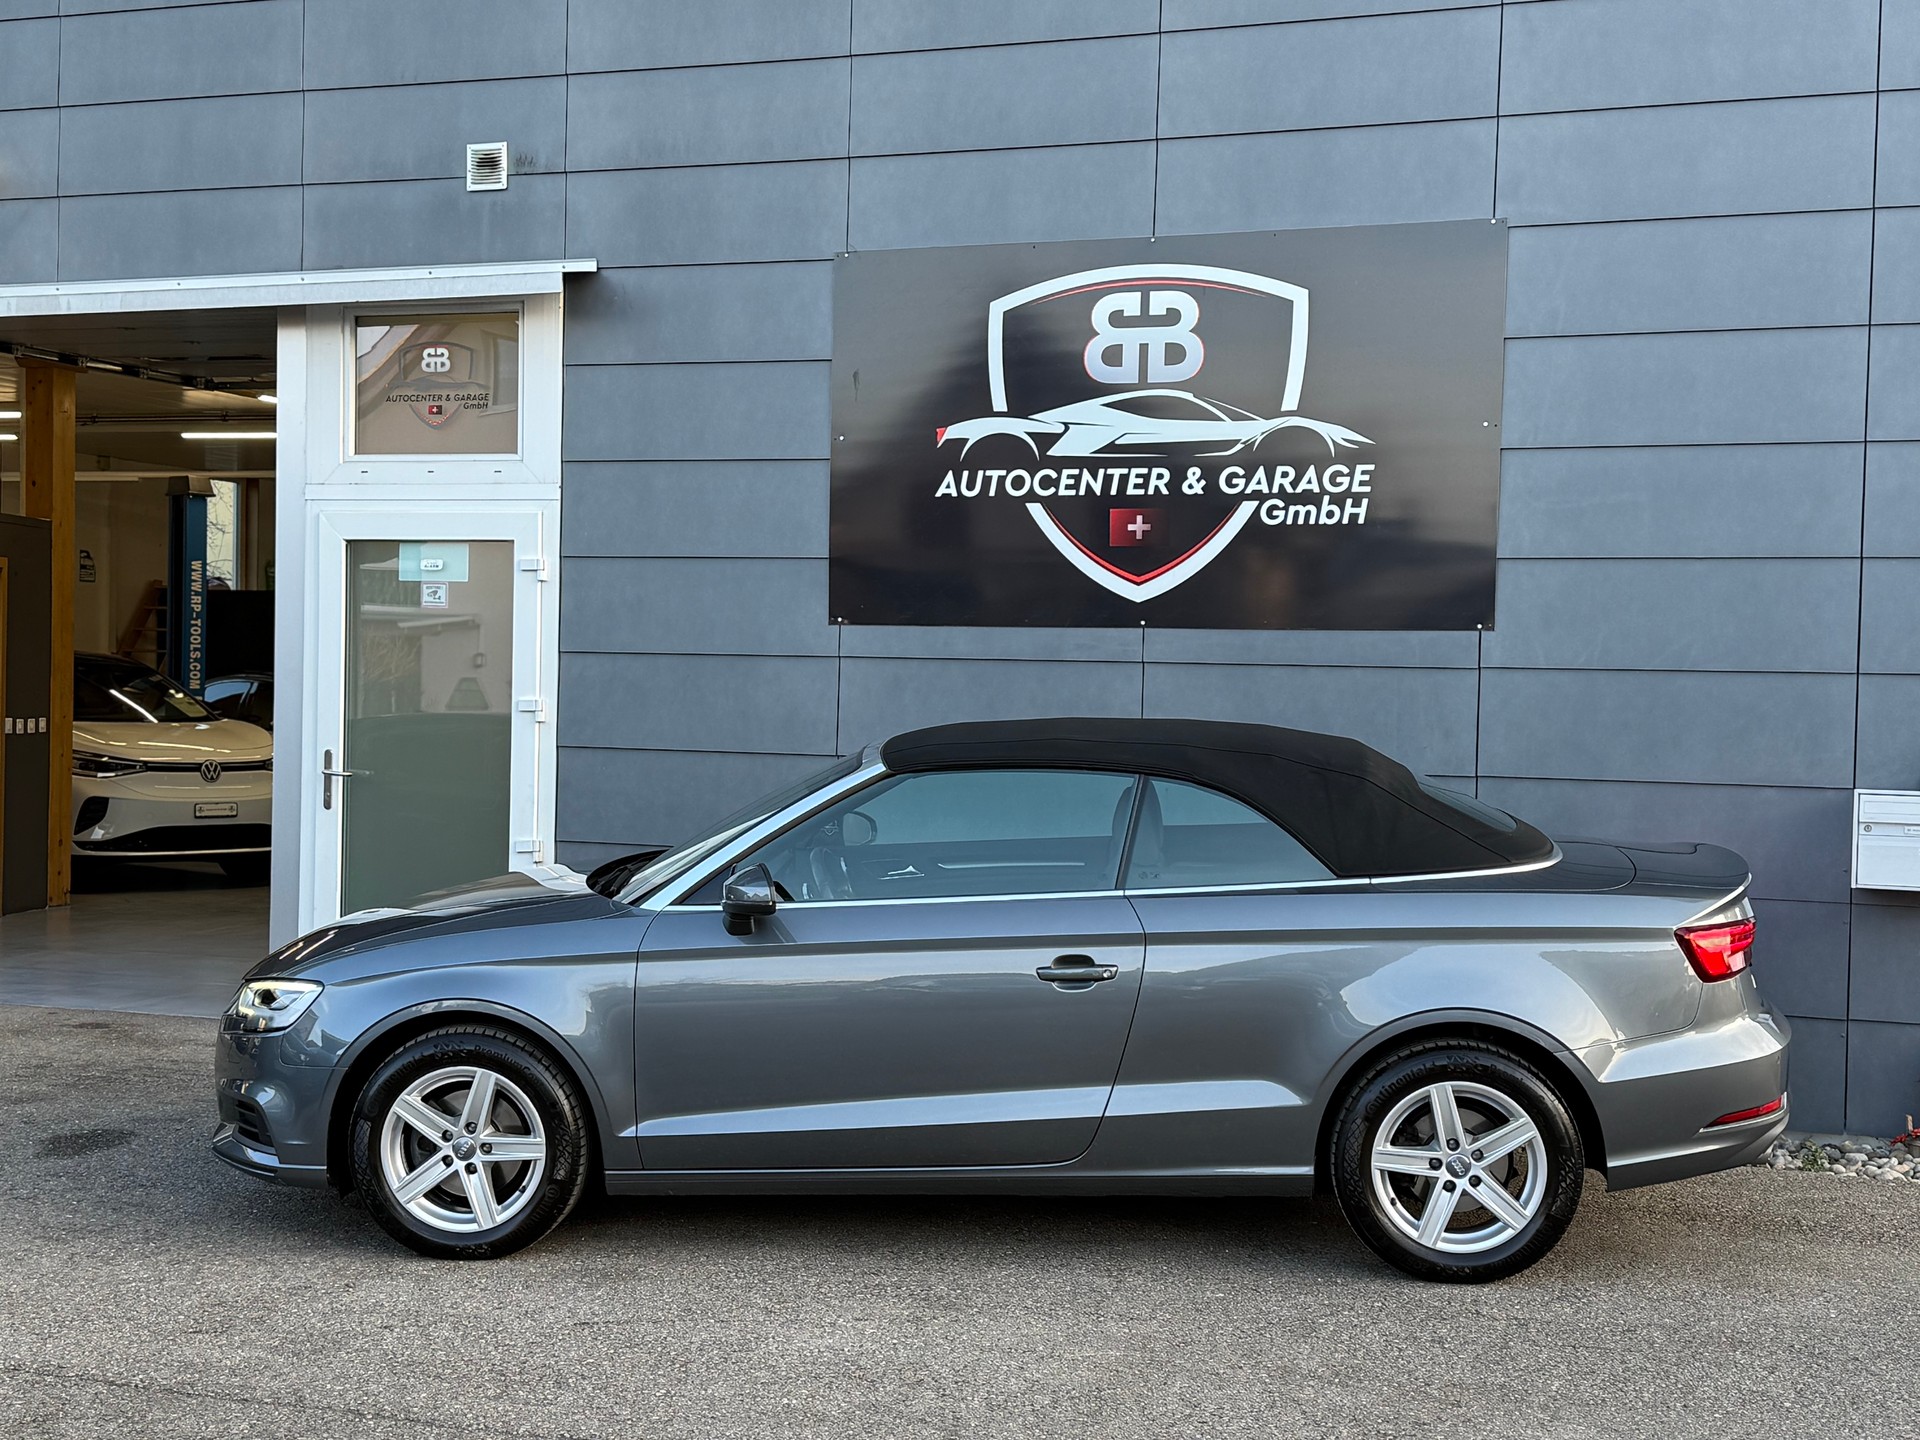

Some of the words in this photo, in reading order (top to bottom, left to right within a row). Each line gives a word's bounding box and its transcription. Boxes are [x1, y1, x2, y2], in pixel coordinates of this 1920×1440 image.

[385, 394, 443, 403] AUTOCENTER
[454, 393, 490, 402] GARAGE
[463, 402, 488, 410] GmbH
[935, 467, 1170, 498] AUTOCENTER
[1181, 468, 1207, 496] &
[1219, 463, 1376, 494] GARAGE
[1260, 496, 1369, 526] GmbH
[189, 560, 202, 689] WWW.RP-TOOLS.COM
[1365, 1063, 1428, 1116] Continental
